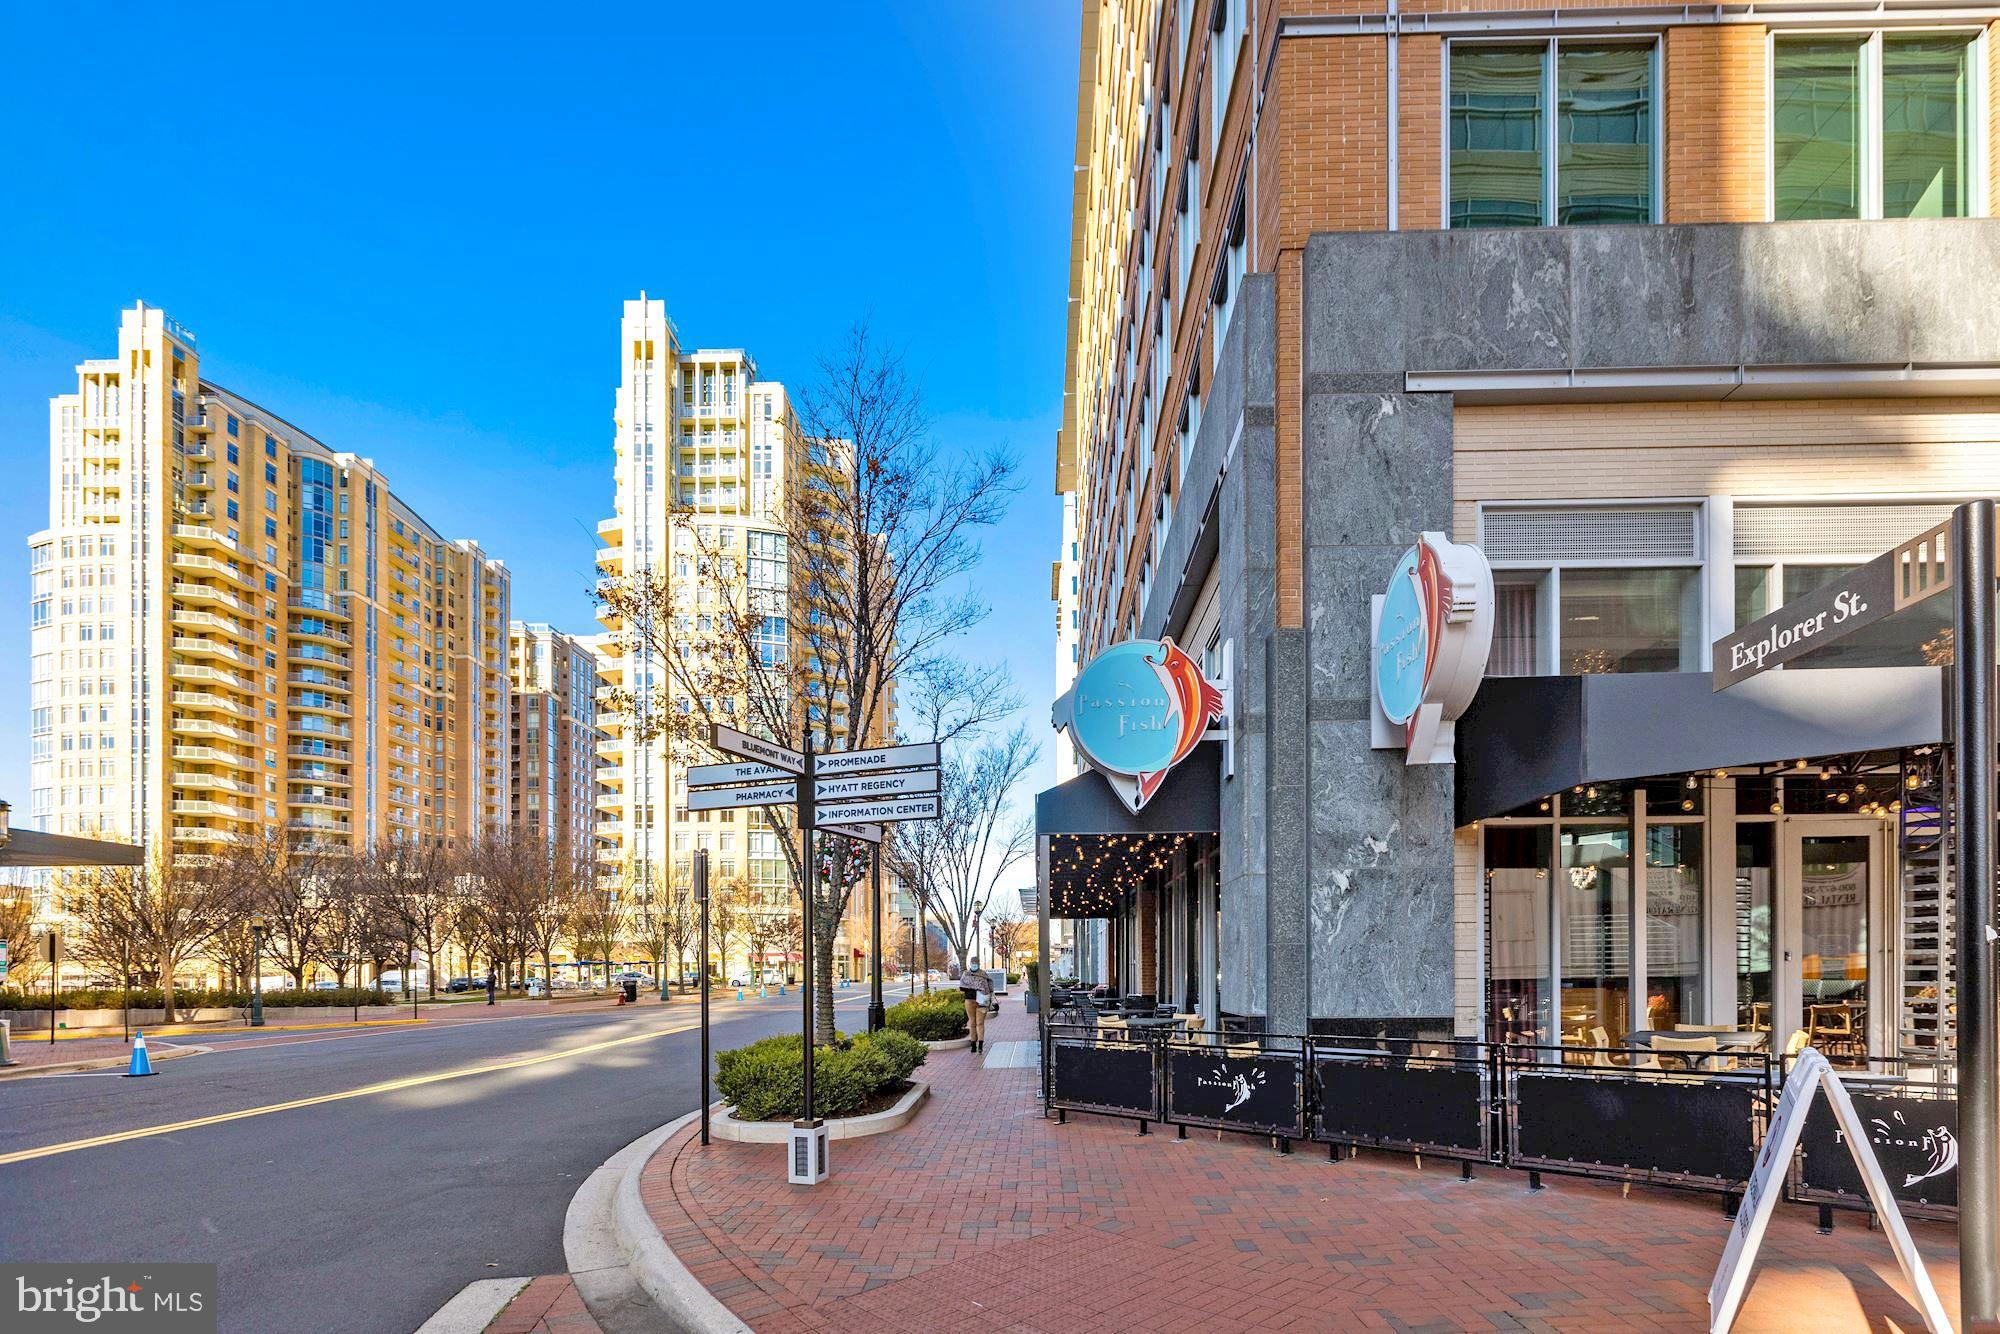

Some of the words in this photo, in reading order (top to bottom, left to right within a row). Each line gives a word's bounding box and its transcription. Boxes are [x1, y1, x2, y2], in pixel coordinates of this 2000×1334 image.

[1730, 611, 1827, 672] Explorer
[1833, 591, 1867, 624] St.
[1379, 616, 1420, 670] Passion
[1396, 641, 1420, 684] Fish
[1079, 694, 1165, 716] Passion
[1117, 714, 1163, 740] Fish
[742, 740, 779, 760] BLUEMONT
[780, 752, 797, 766] WAY
[828, 754, 886, 768] PROMENADE
[736, 767, 752, 776] THE
[754, 765, 783, 775] AVAN
[736, 789, 783, 801] PHARMACY
[828, 783, 858, 793] HYATT
[861, 779, 905, 791] REGENCY
[828, 806, 894, 819] INFORMATION
[896, 803, 934, 814] CENTER
